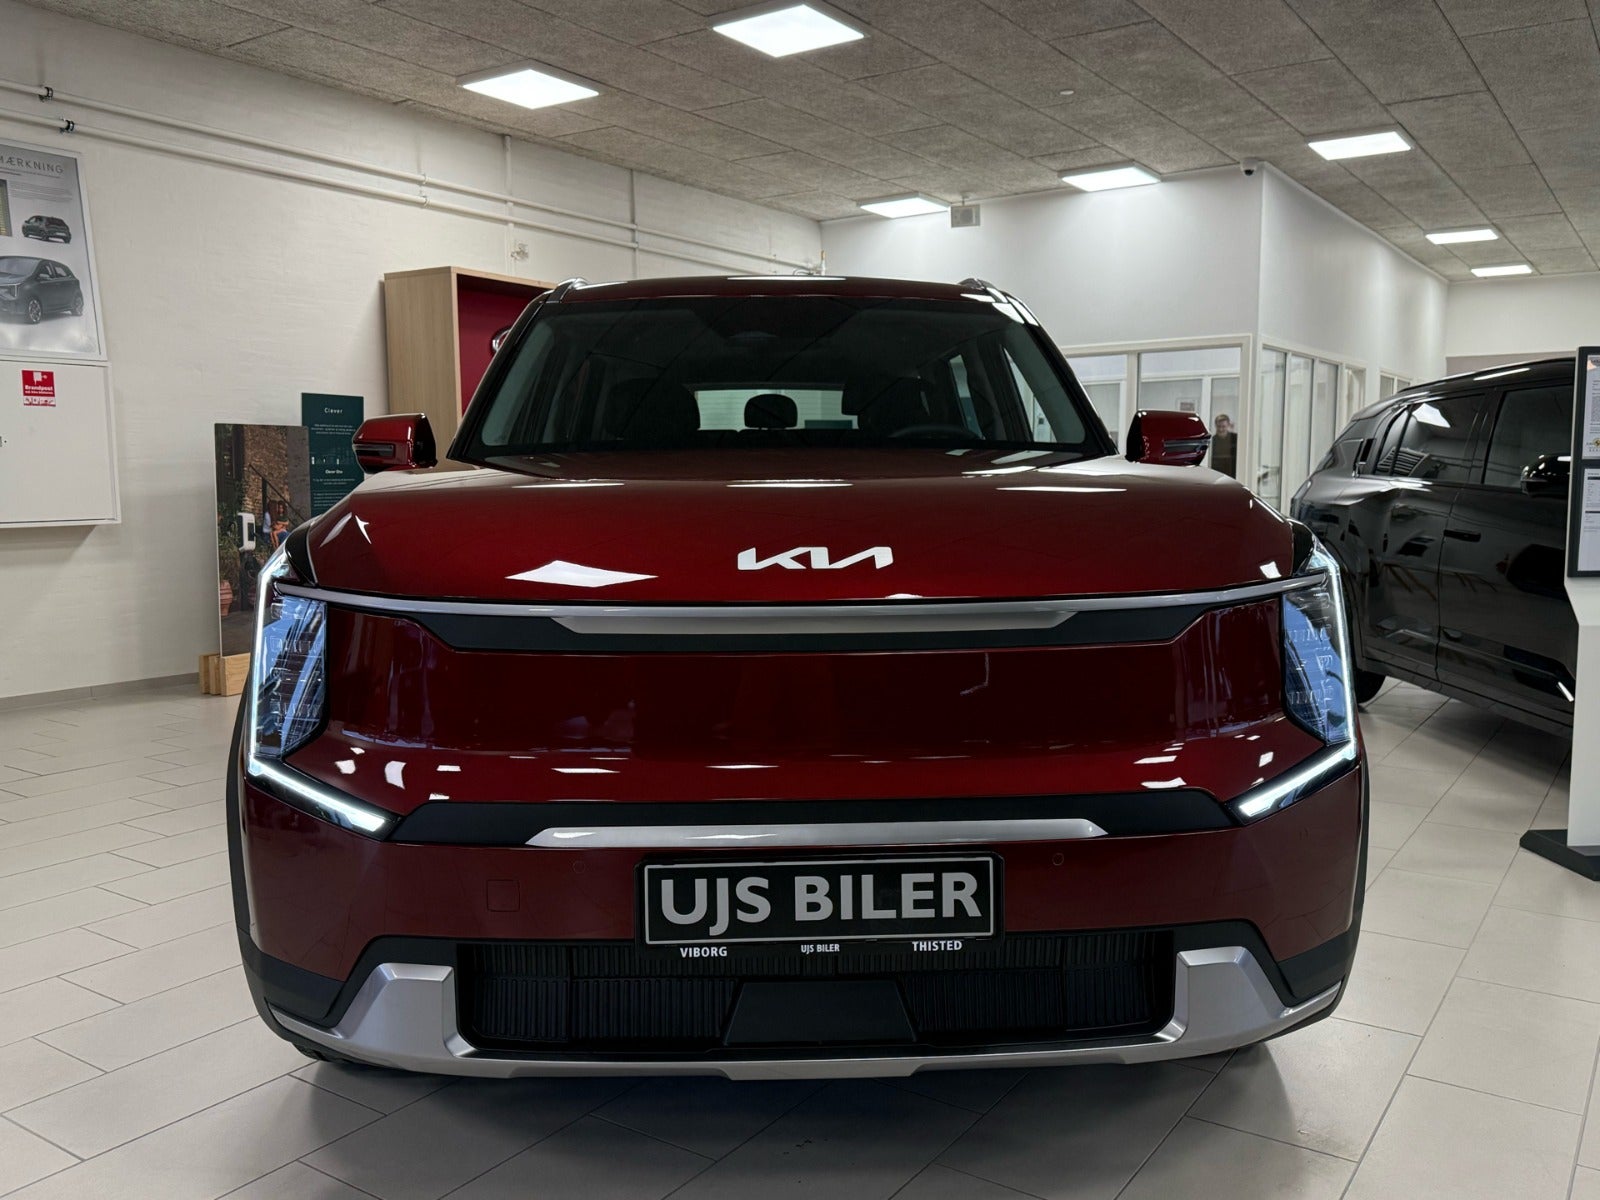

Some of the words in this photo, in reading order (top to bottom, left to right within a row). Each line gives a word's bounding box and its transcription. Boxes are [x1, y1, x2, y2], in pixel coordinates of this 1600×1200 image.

[737, 546, 894, 570] KIA
[661, 876, 772, 936] UJS
[794, 871, 983, 922] BILER
[680, 946, 728, 958] VIBORG
[800, 944, 815, 953] UJS
[816, 943, 840, 953] BILER
[911, 940, 963, 952] THISTED
